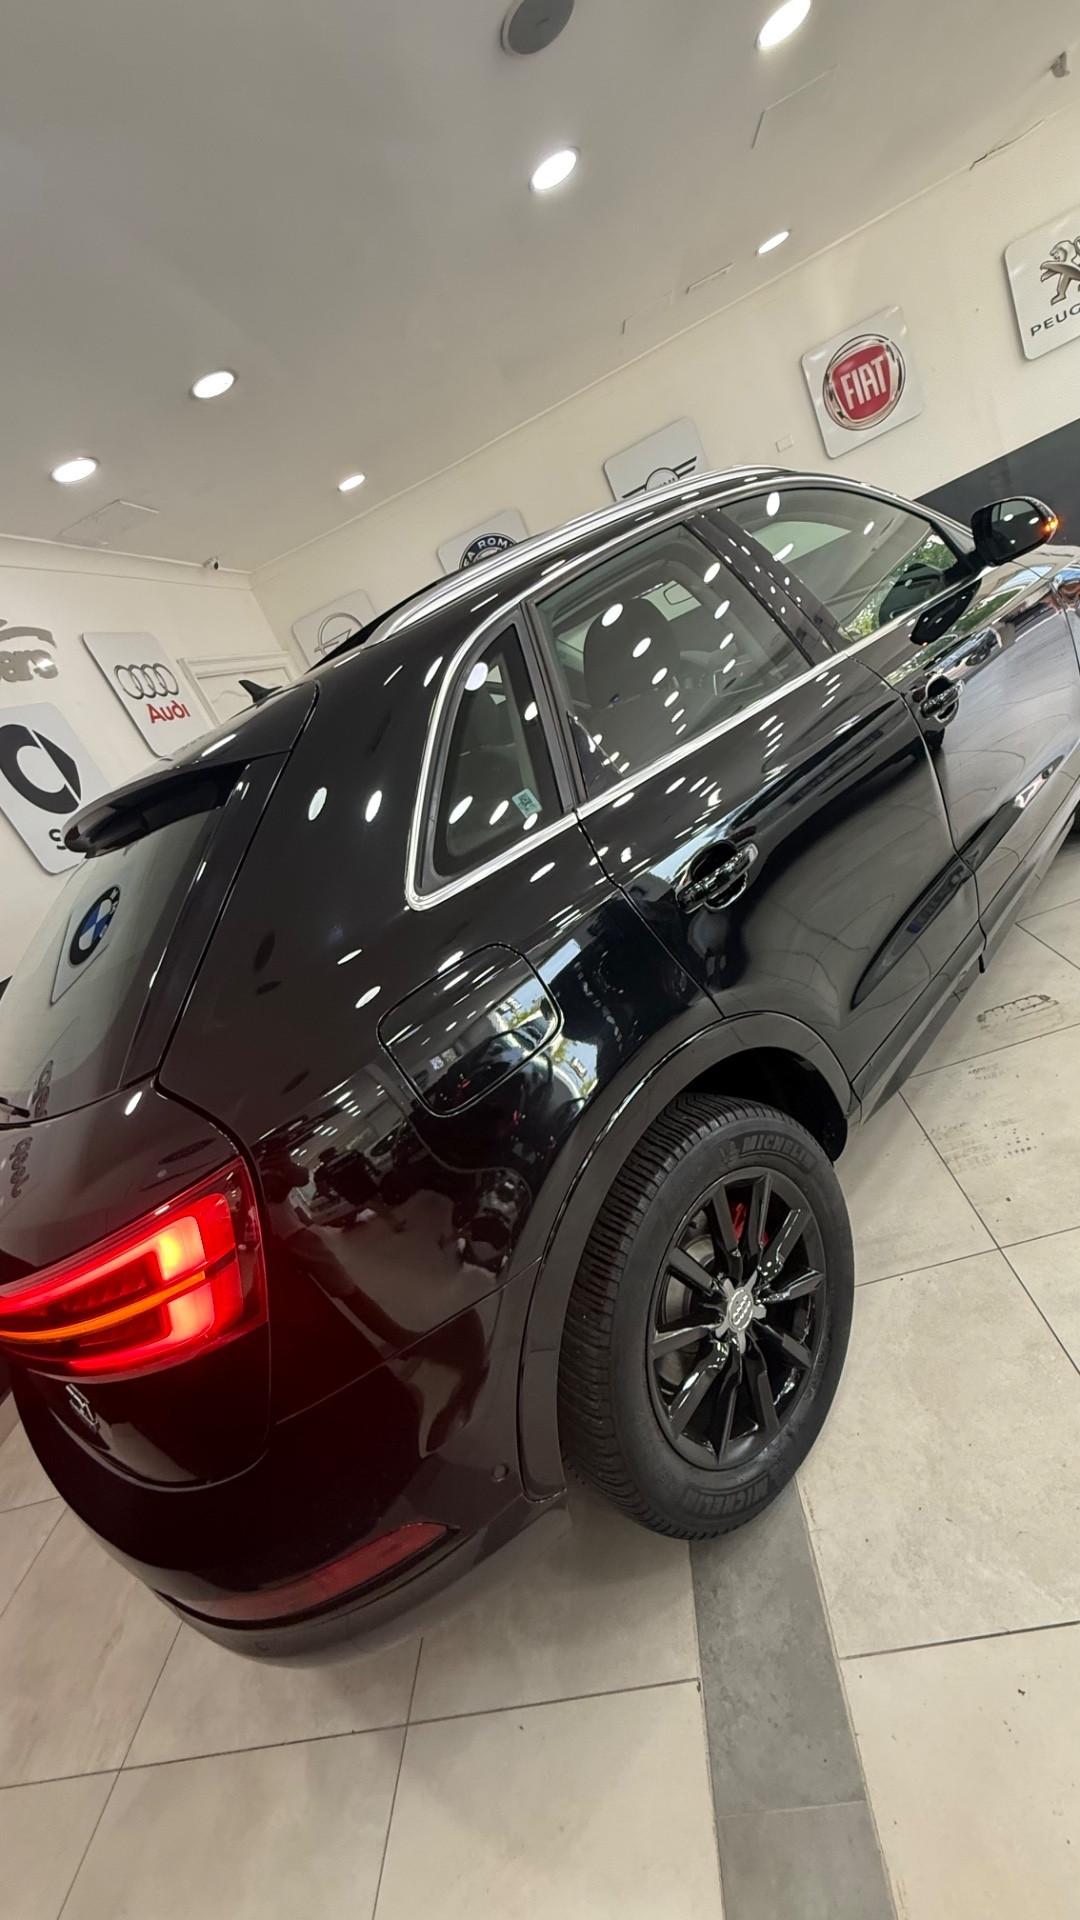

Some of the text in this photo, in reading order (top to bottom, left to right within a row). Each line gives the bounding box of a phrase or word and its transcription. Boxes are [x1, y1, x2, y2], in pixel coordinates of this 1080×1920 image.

[1030, 303, 1080, 337] PEUG
[840, 355, 886, 410] FIAT
[477, 537, 512, 549] ROM
[146, 700, 191, 723] Audi
[741, 1134, 817, 1171] MICHELIN
[683, 1476, 768, 1514] MICHELIN
